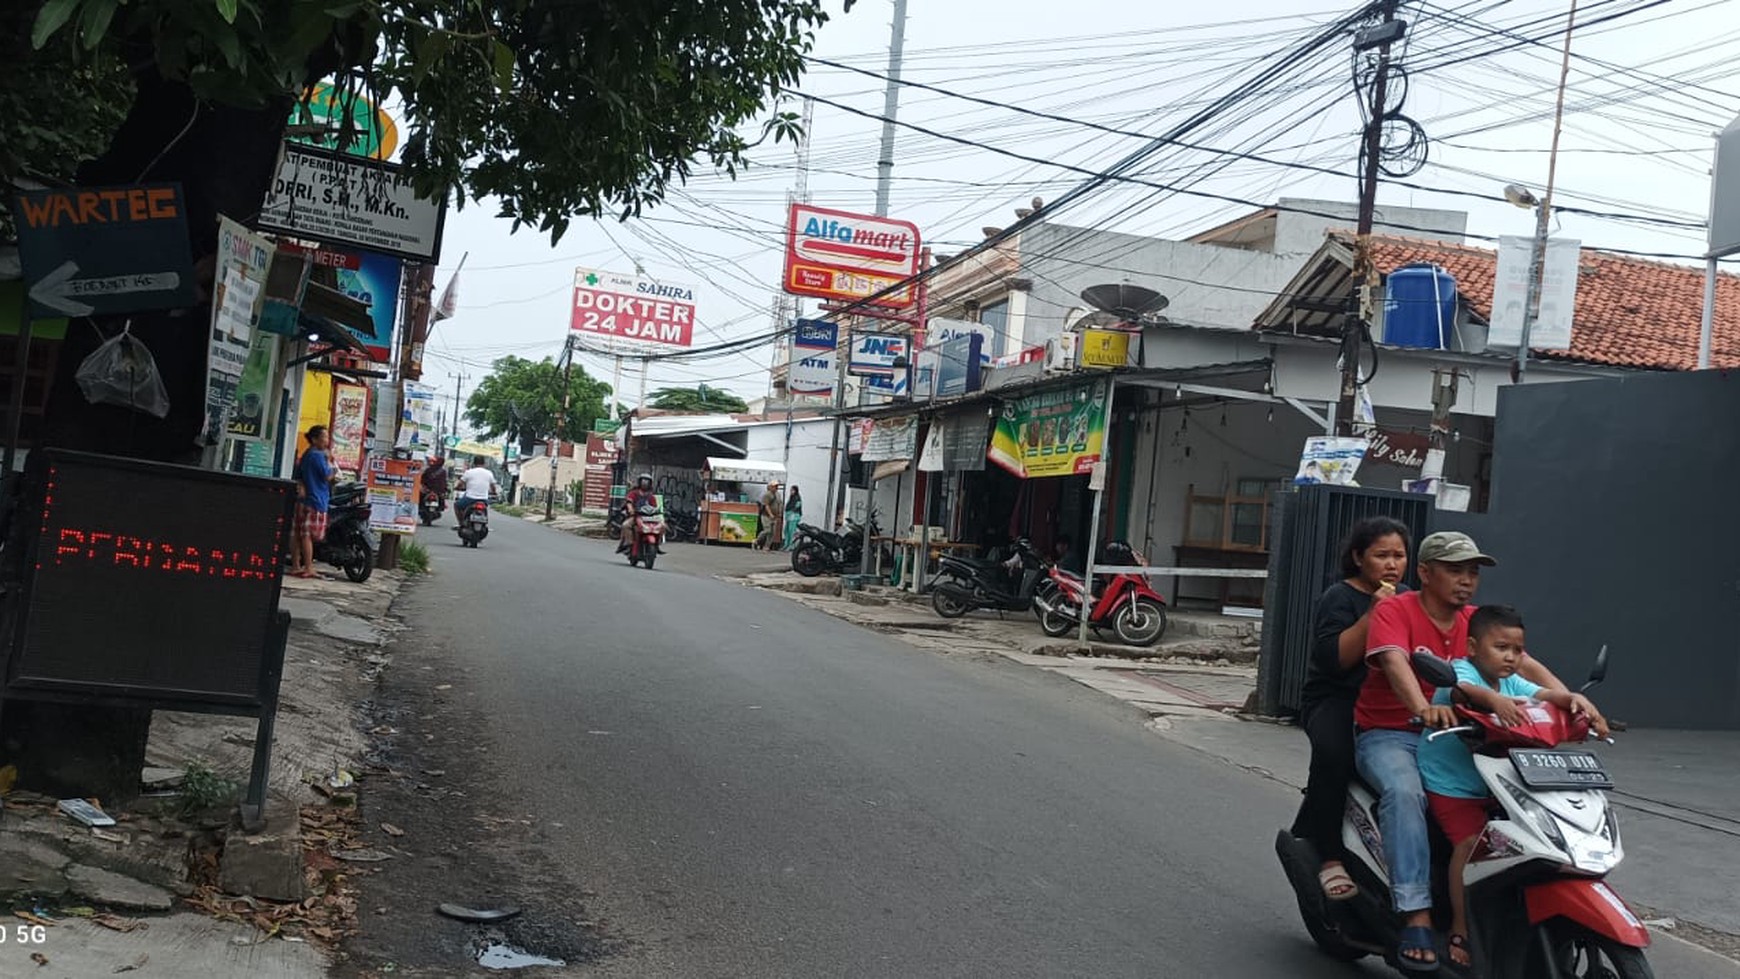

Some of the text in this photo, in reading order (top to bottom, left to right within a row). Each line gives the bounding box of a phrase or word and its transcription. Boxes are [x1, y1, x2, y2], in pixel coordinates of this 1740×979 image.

[804, 217, 910, 251] Alfamart
[315, 251, 347, 267] METER
[636, 282, 693, 301] SAHIRA
[576, 290, 690, 324] DOKTER
[583, 312, 682, 343] 24 JAM
[859, 338, 904, 356] JNE
[799, 357, 829, 369] ATM
[1518, 753, 1530, 768] B
[1533, 754, 1567, 769] 3260
